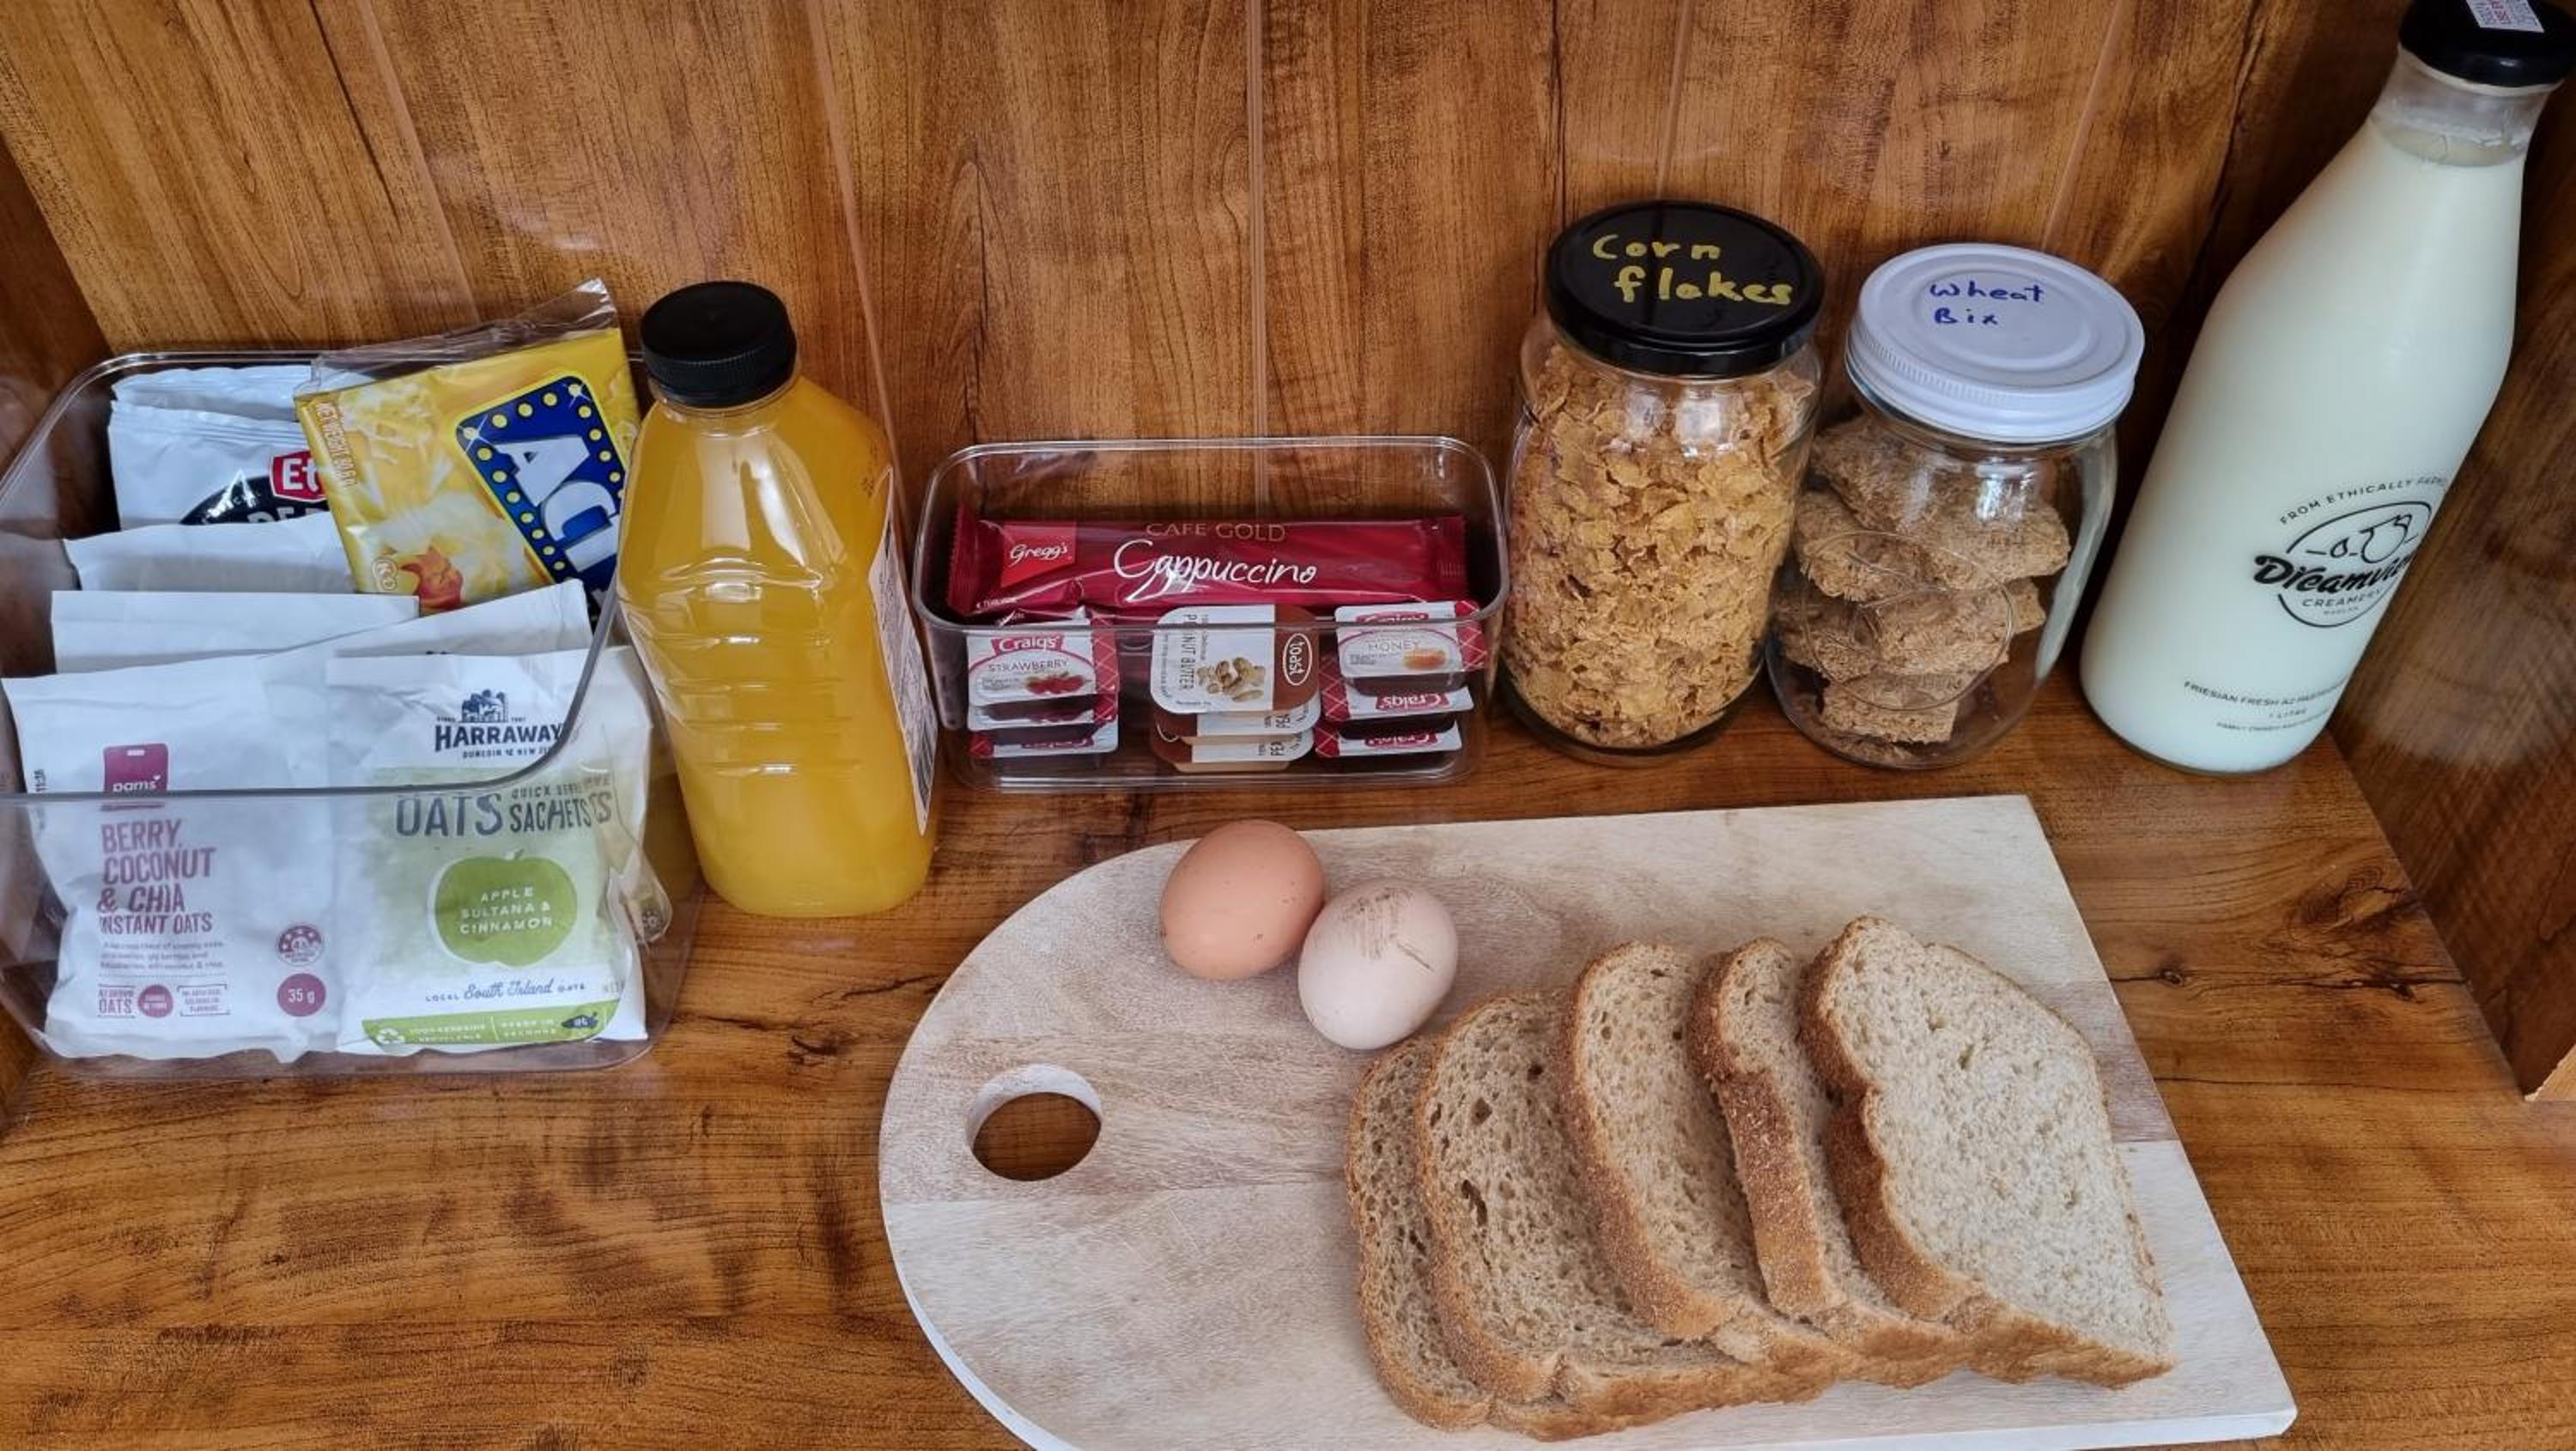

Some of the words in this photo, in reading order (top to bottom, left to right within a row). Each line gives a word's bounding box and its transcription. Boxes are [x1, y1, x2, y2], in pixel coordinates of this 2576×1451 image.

[1592, 233, 1721, 260] Corn
[1613, 264, 1793, 306] flakes
[1934, 307, 1999, 325] Bix
[282, 458, 319, 493] Et
[2279, 501, 2321, 525] FROM
[2325, 479, 2412, 504] ETHICALLY
[1215, 522, 1285, 542] GOLD
[1008, 541, 1068, 568] Gregg's
[1114, 538, 1317, 603] Cappuccino
[2253, 554, 2414, 594] Dreamvi
[988, 659, 1069, 672] STRAWBERRY
[1289, 640, 1307, 676] toast
[434, 723, 564, 752] HARRAWAY
[396, 792, 503, 837] OATS
[508, 798, 592, 833] SACHETS
[103, 847, 216, 885] COCONUT
[96, 888, 118, 914] &
[129, 883, 186, 913] CHIA
[480, 886, 535, 902] APPLE
[173, 913, 213, 935] OATS
[460, 902, 536, 920] SULTANA
[459, 917, 552, 935] CINNAMON
[288, 988, 303, 1003] 35
[463, 980, 505, 1000] South
[507, 978, 555, 997] Island
[98, 999, 132, 1014] OATS
